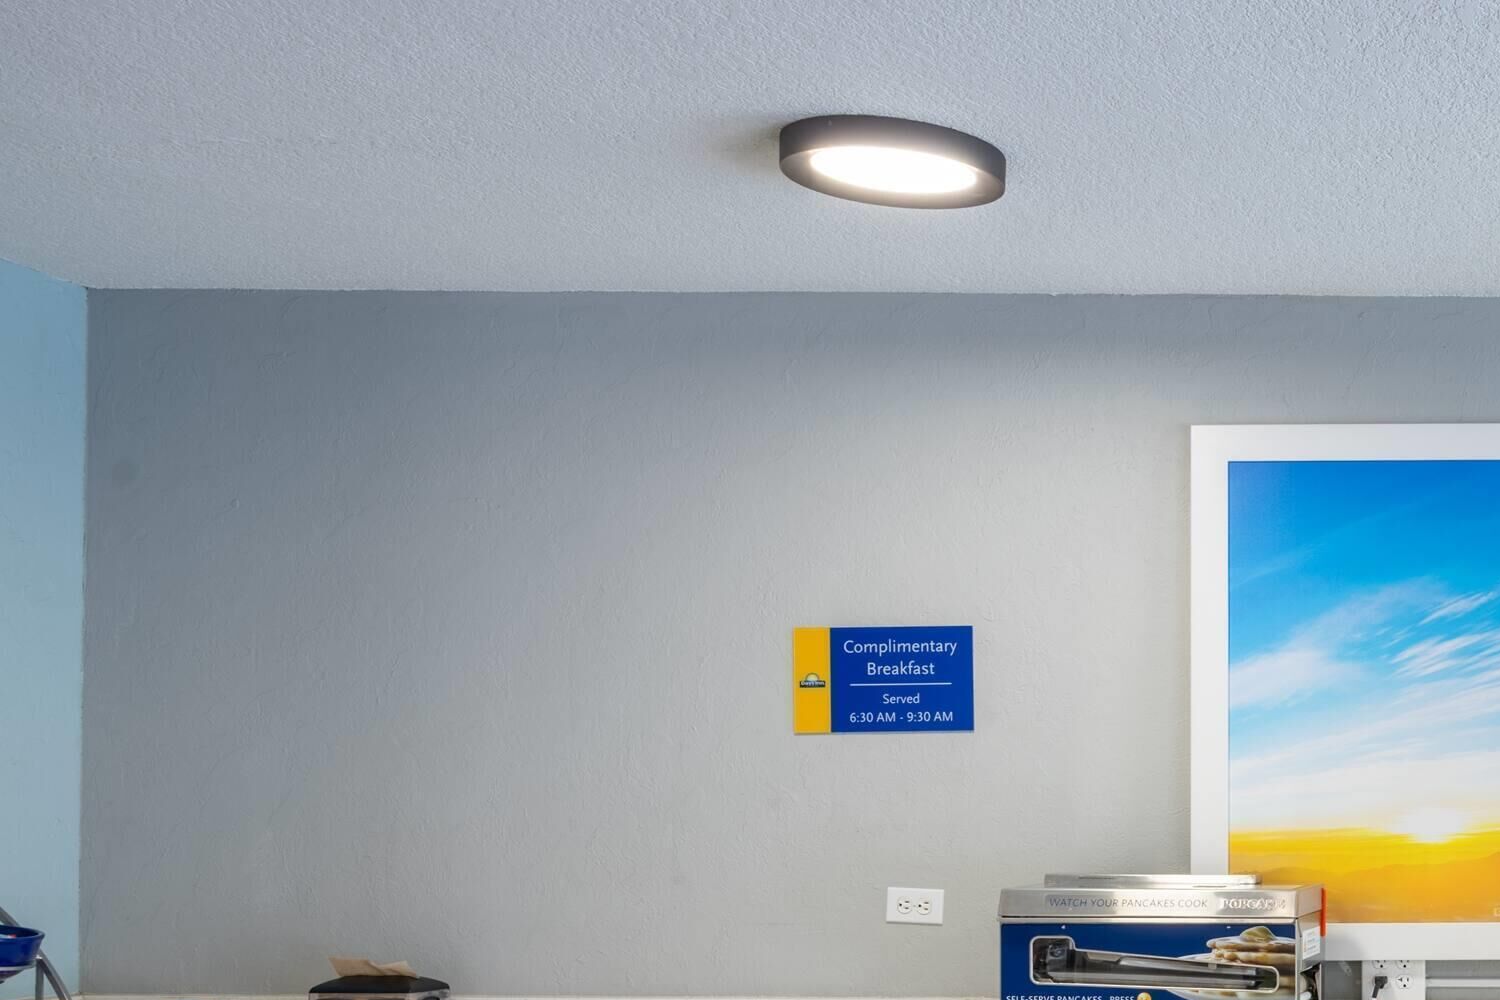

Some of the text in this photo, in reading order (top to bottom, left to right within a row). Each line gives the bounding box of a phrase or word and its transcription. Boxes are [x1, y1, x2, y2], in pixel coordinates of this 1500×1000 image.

[843, 639, 957, 657] Complimentary
[867, 660, 935, 675] Breakfast
[882, 692, 920, 704] Served
[850, 712, 874, 723] 6:30
[876, 711, 896, 722] AM
[907, 711, 931, 722] 9:30
[933, 711, 953, 721] AM
[1049, 898, 1208, 908] WATCH YOUR PANCAKES COOK
